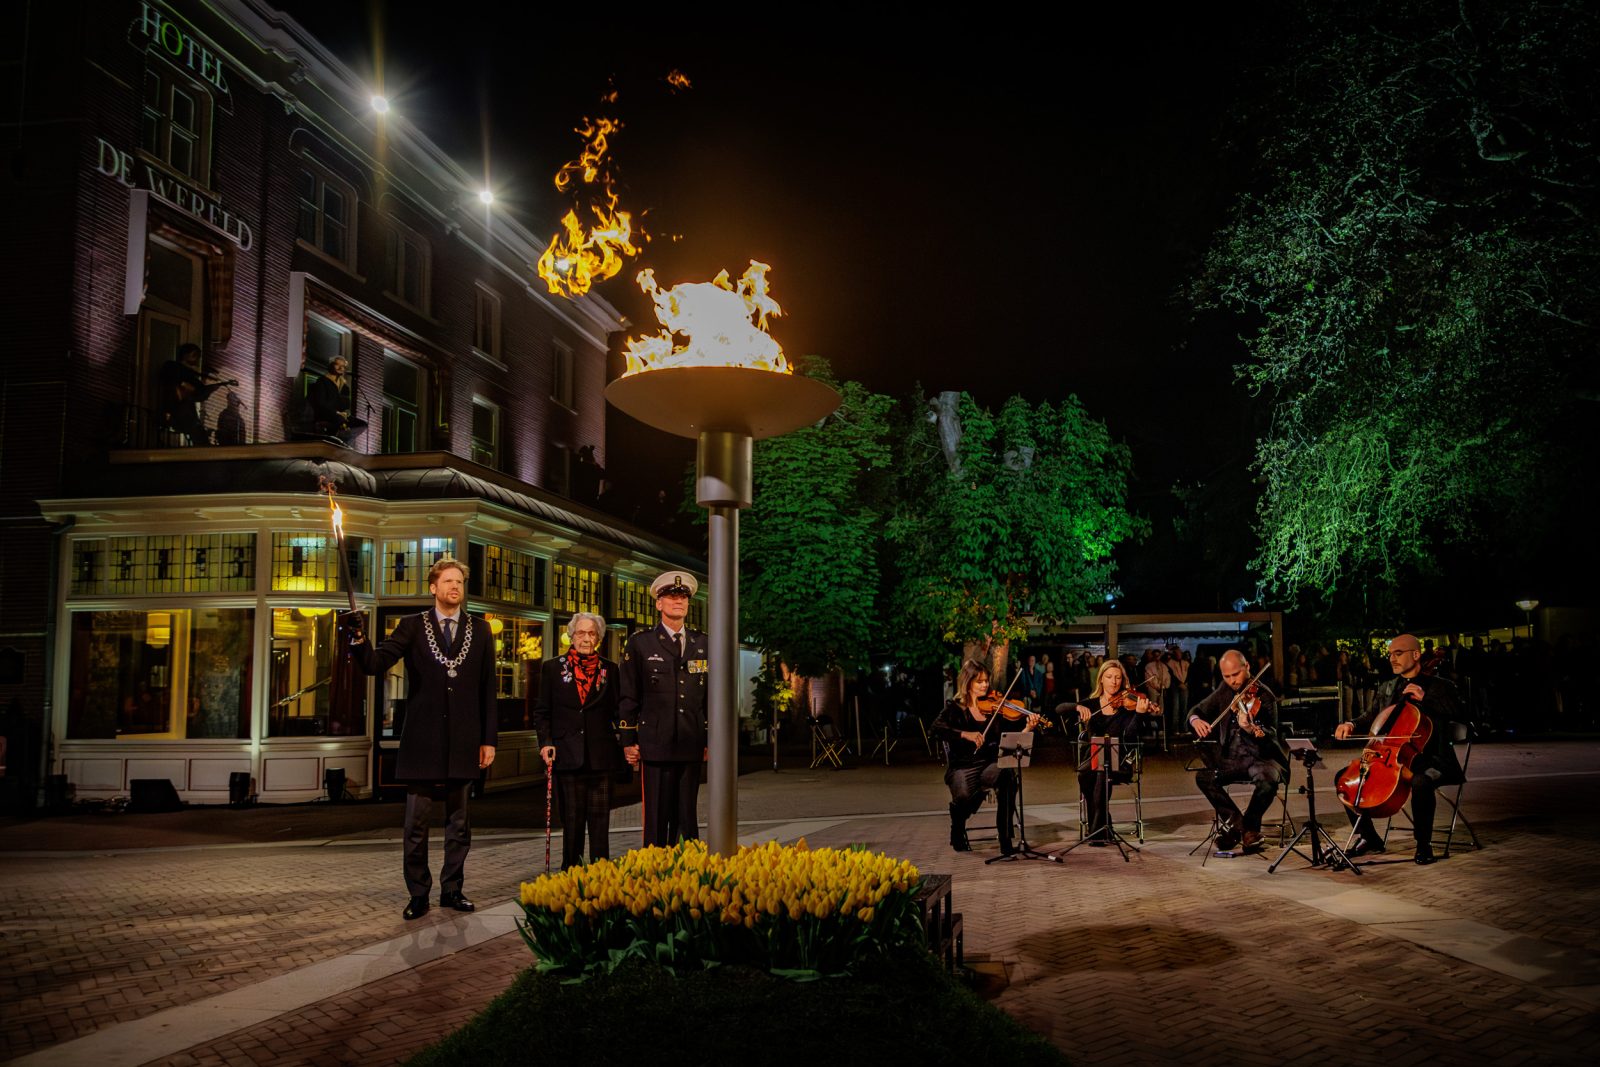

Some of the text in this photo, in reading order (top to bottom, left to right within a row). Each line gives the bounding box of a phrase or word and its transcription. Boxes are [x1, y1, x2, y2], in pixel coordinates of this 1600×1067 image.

[140, 1, 229, 94] HOTEL
[95, 137, 253, 251] DE WERELD
